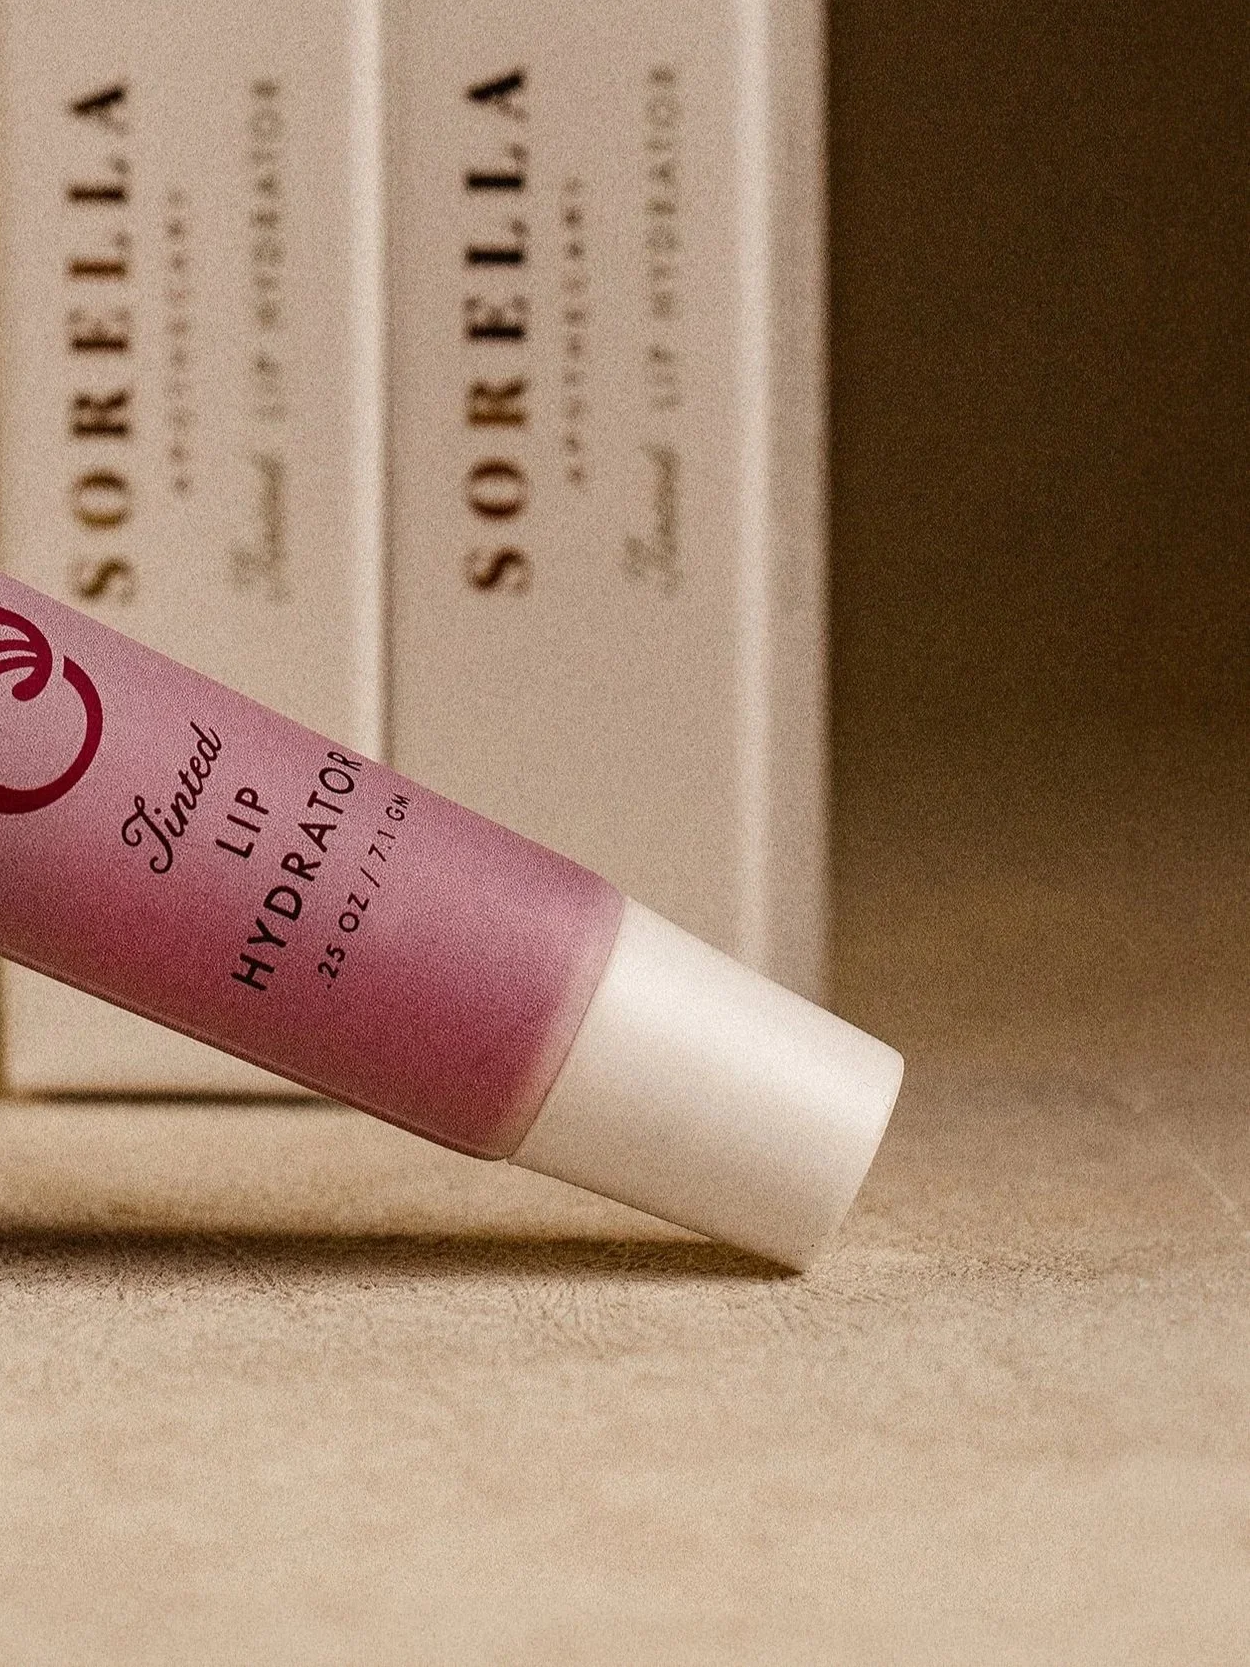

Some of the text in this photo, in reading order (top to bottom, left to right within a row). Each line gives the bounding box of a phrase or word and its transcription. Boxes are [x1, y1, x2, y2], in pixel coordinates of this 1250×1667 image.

[67, 81, 132, 602] SORELLA
[465, 66, 530, 595] SORELLA
[121, 721, 222, 874] Tinted
[216, 787, 269, 858] LIP
[386, 793, 410, 821] GM
[231, 750, 362, 991] HYDRATOR
[360, 867, 380, 888] /
[368, 830, 396, 862] 7.1
[338, 892, 369, 933] OZ
